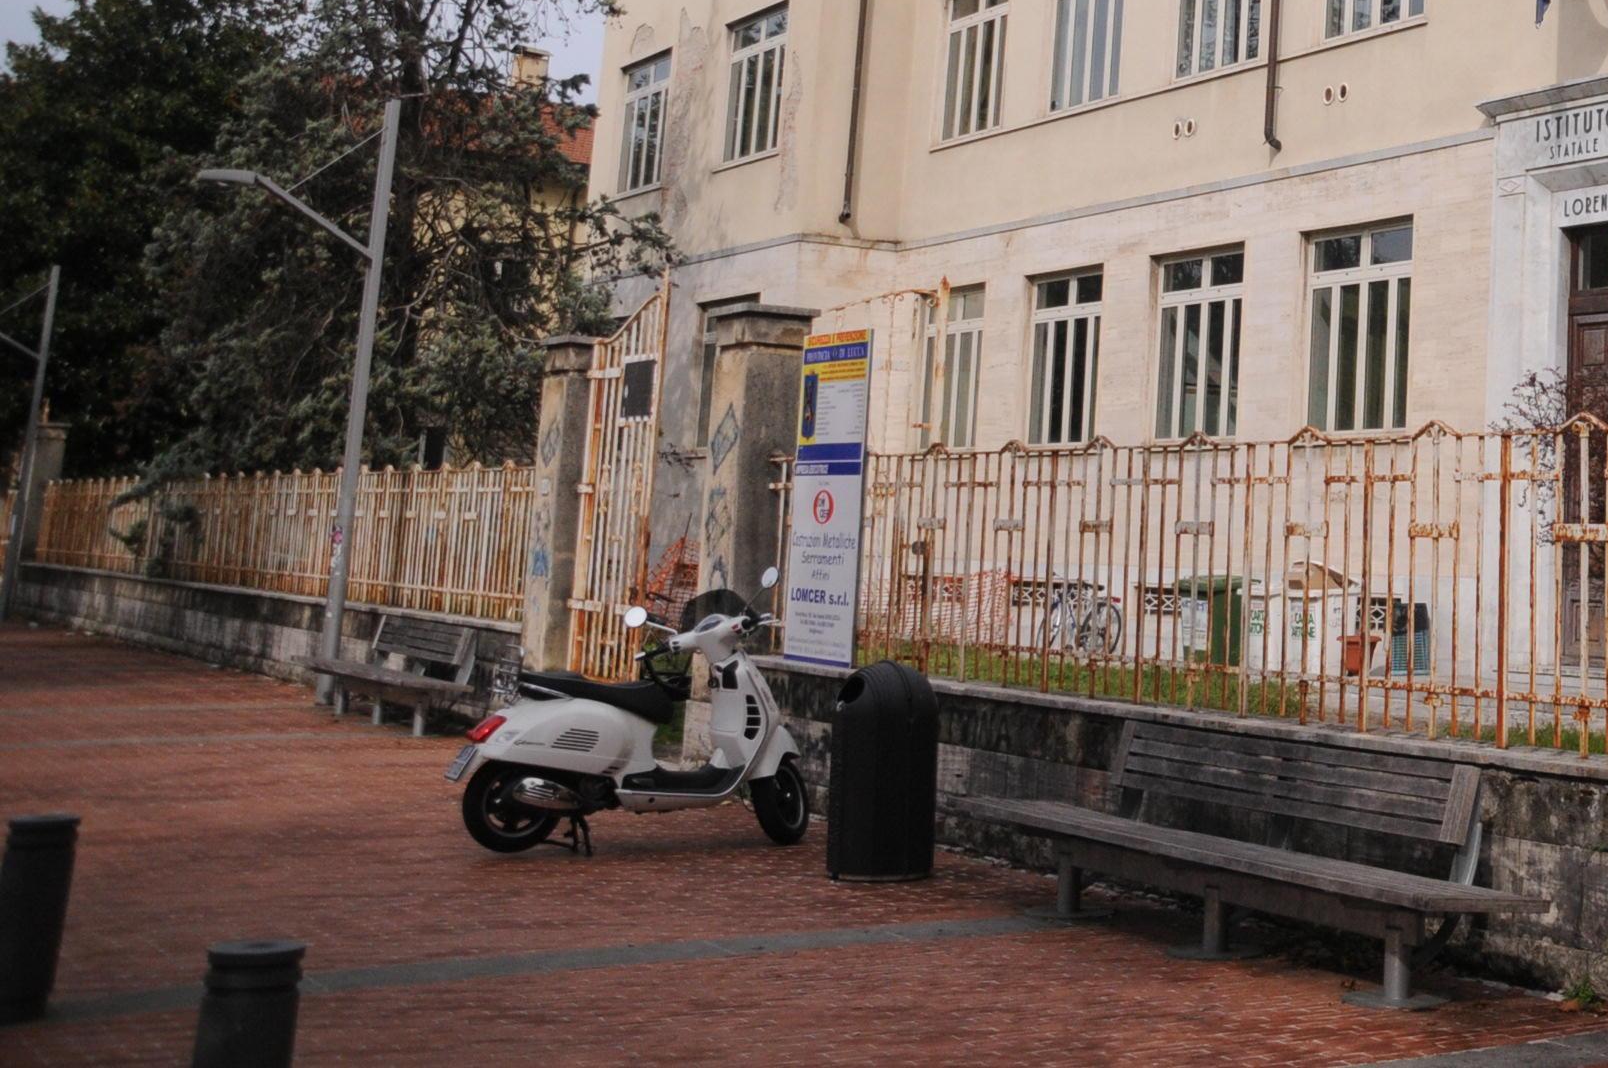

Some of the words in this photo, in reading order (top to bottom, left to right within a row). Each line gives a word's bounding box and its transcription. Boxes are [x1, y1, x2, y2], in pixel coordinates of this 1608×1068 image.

[1549, 137, 1599, 160] STATALE
[801, 550, 845, 566] Serramenti
[791, 587, 826, 605] LOMCER
[828, 591, 849, 607] s.r.l.
